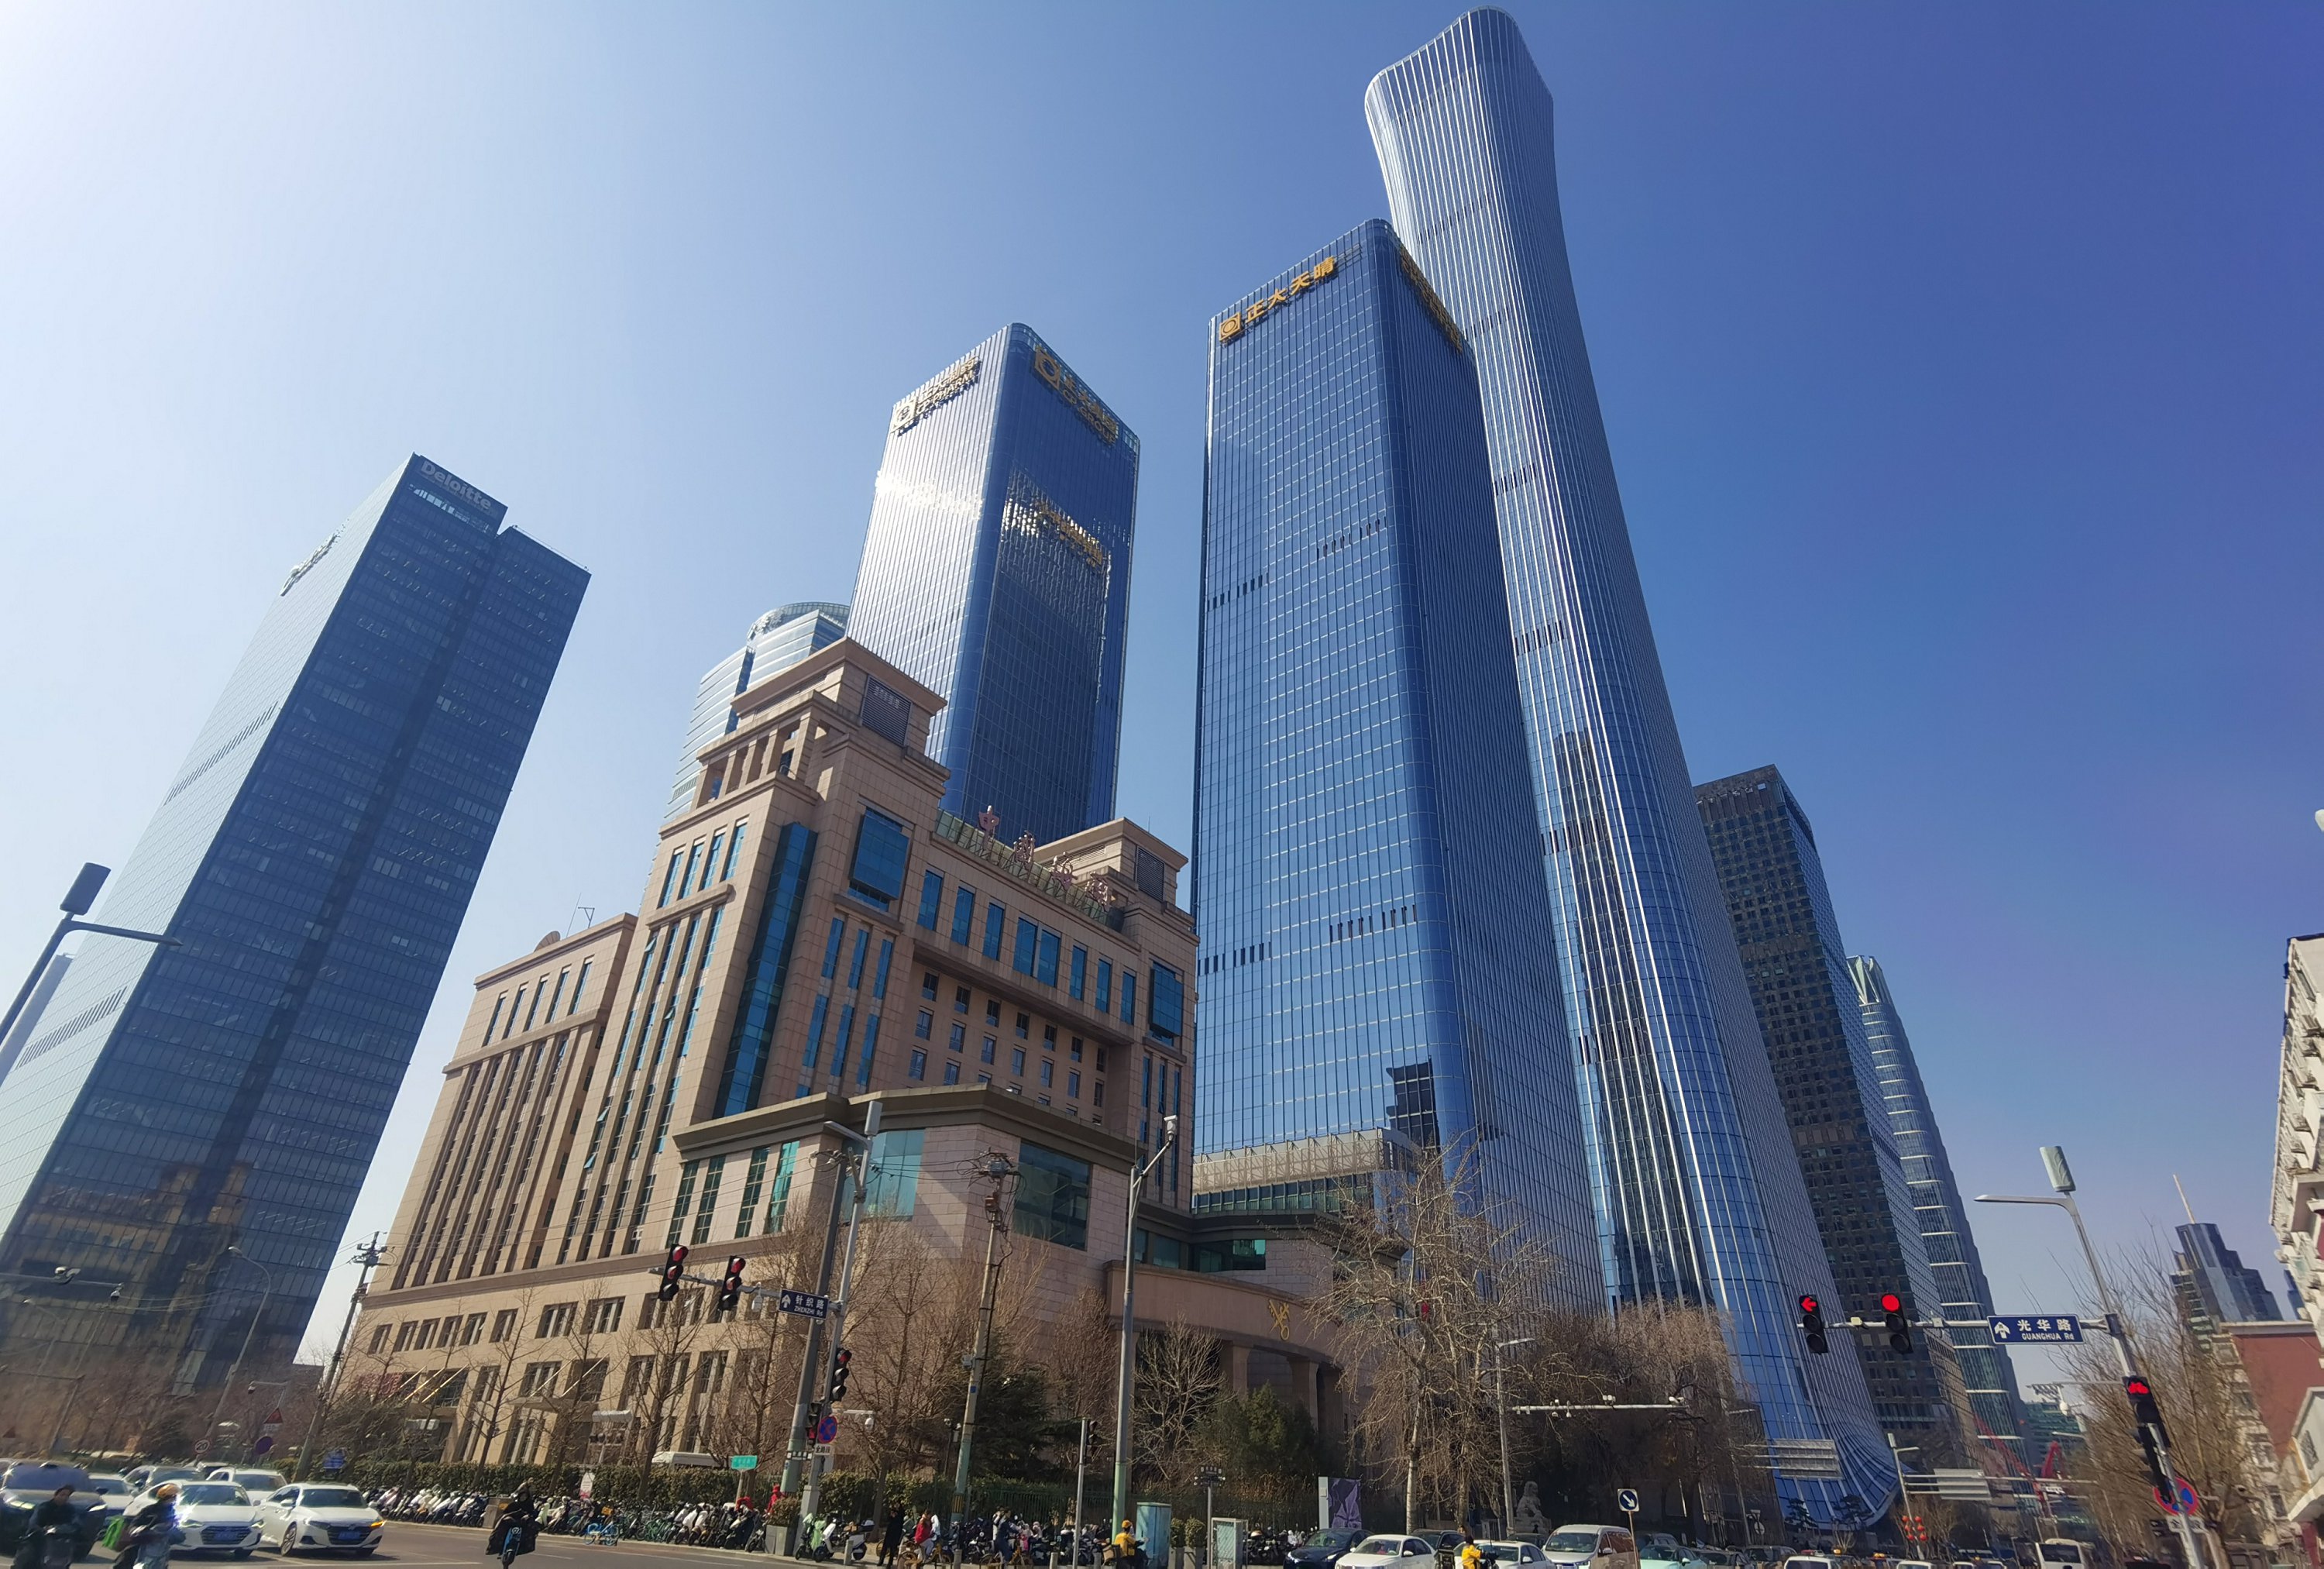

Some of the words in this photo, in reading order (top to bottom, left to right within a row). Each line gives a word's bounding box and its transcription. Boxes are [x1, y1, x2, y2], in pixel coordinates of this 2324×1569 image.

[1244, 256, 1336, 324] 正大天晴
[932, 369, 974, 404] PHARM
[1078, 406, 1116, 445] GROUP
[421, 459, 492, 510] Deloitte
[795, 1295, 824, 1309] 针织路
[2017, 1319, 2072, 1332] 光华路
